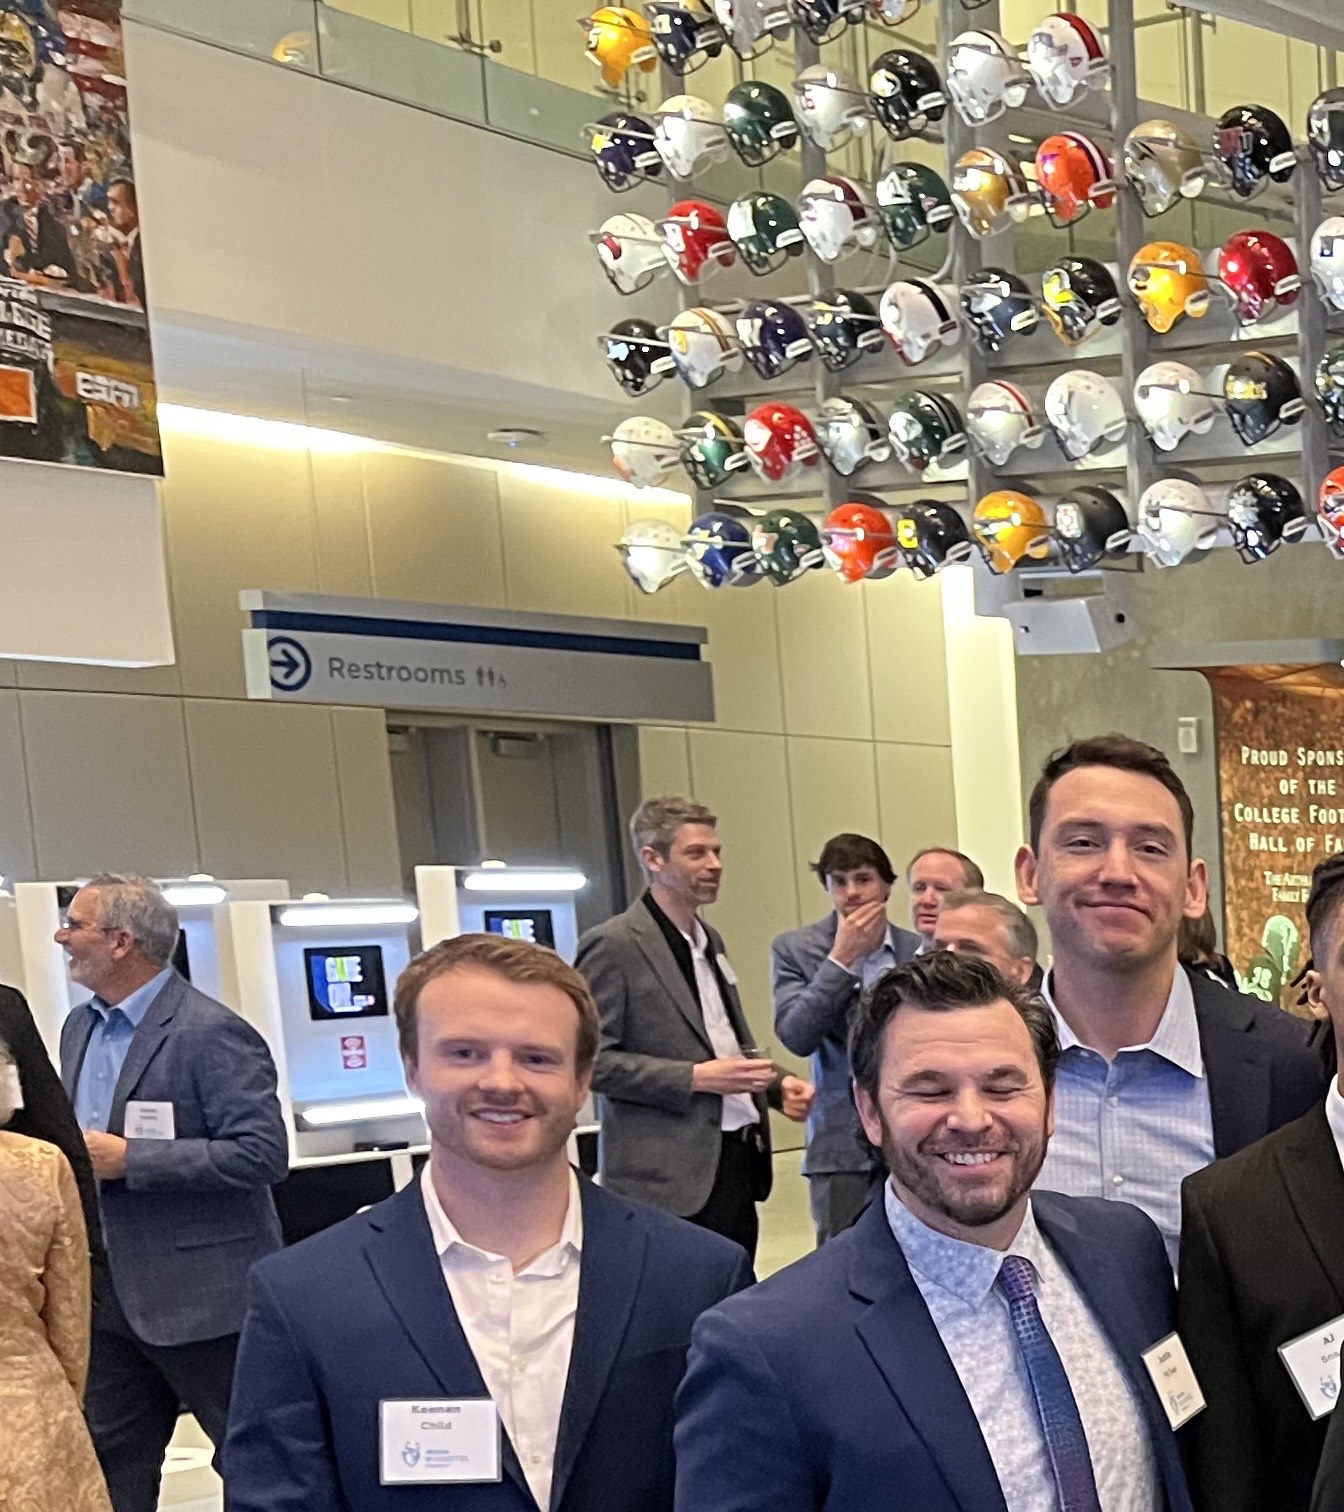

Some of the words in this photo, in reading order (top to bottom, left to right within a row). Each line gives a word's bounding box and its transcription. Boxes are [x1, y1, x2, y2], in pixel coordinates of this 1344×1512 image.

[327, 656, 466, 687] Restrooms
[1241, 746, 1288, 766] PROUD
[1279, 779, 1299, 796] OF
[1308, 779, 1336, 796] THE
[1234, 803, 1300, 824] COLLEGE
[1249, 832, 1288, 853] HALL
[1296, 836, 1315, 853] OF
